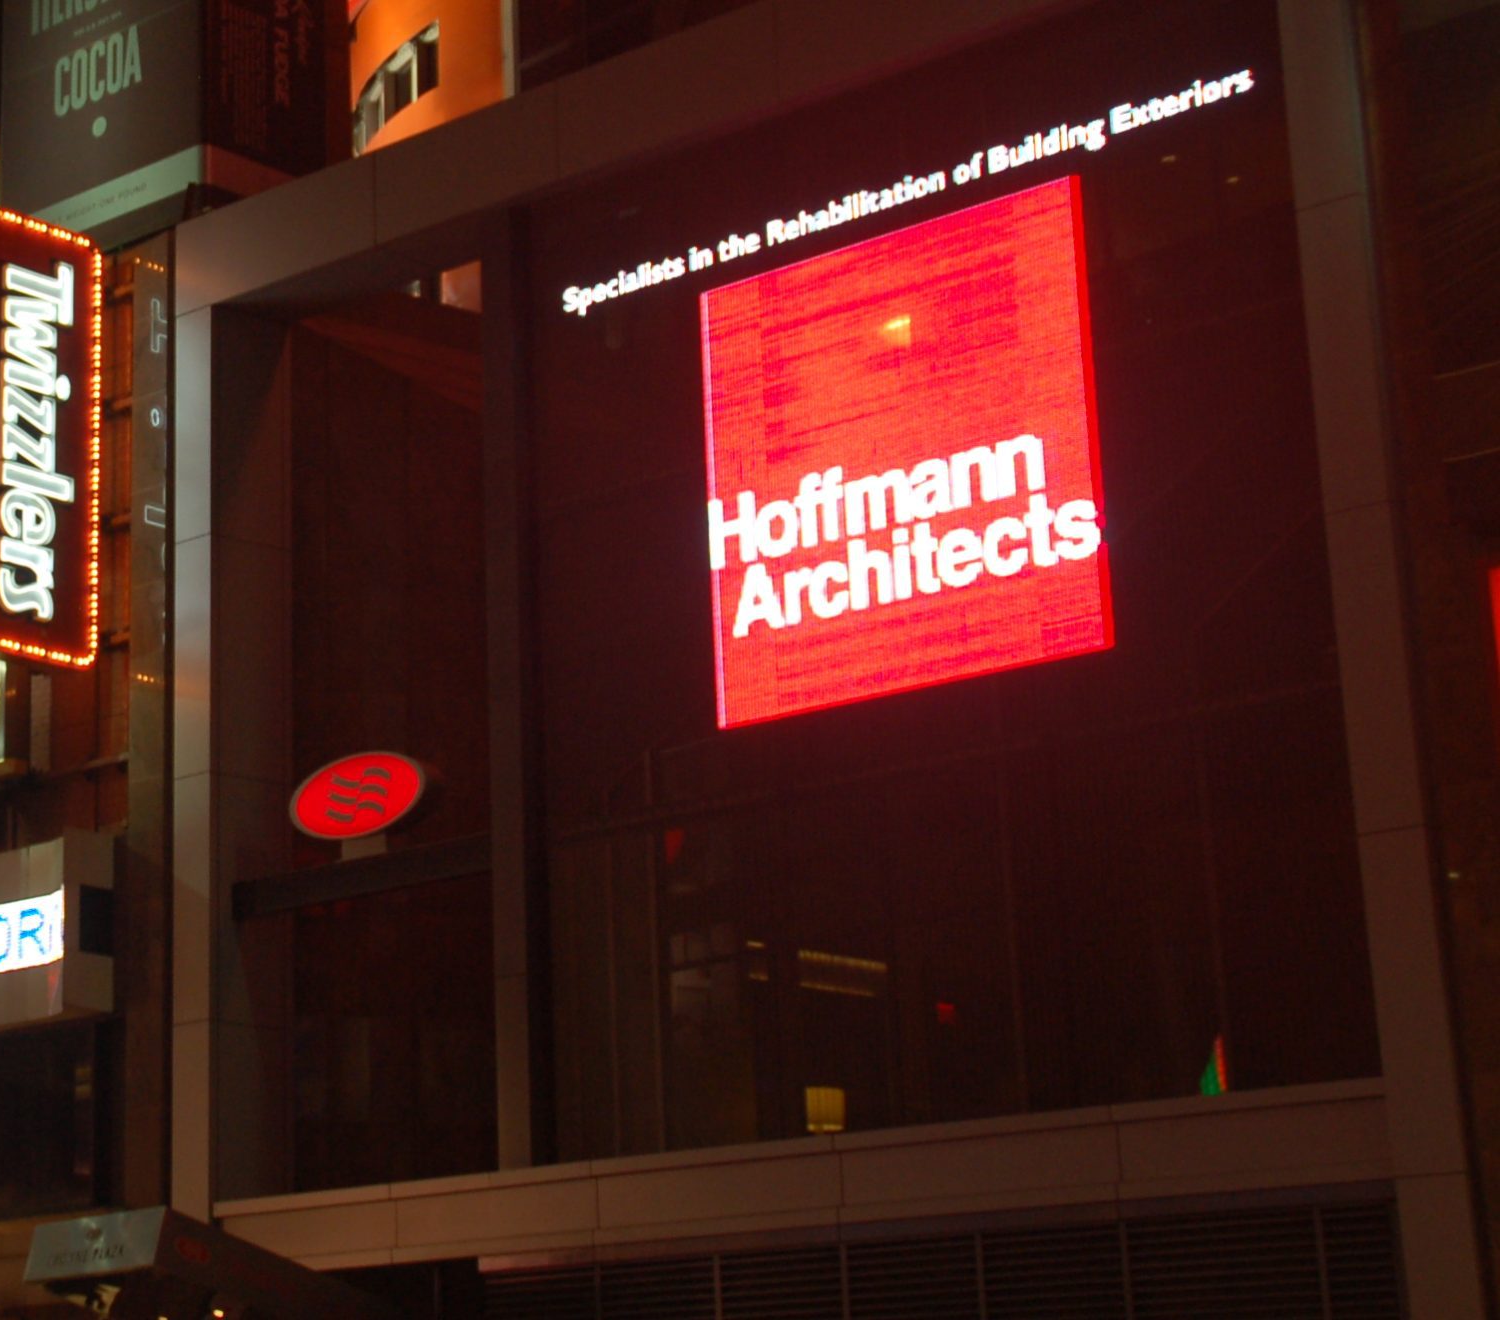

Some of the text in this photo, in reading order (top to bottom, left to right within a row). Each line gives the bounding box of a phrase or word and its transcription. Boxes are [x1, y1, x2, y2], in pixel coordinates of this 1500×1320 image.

[54, 25, 142, 117] COCOA
[562, 68, 1256, 317] Specialists in the Rehabilitation of Building Exteriors
[707, 433, 1047, 571] Hoffmann
[732, 493, 1102, 640] Architects
